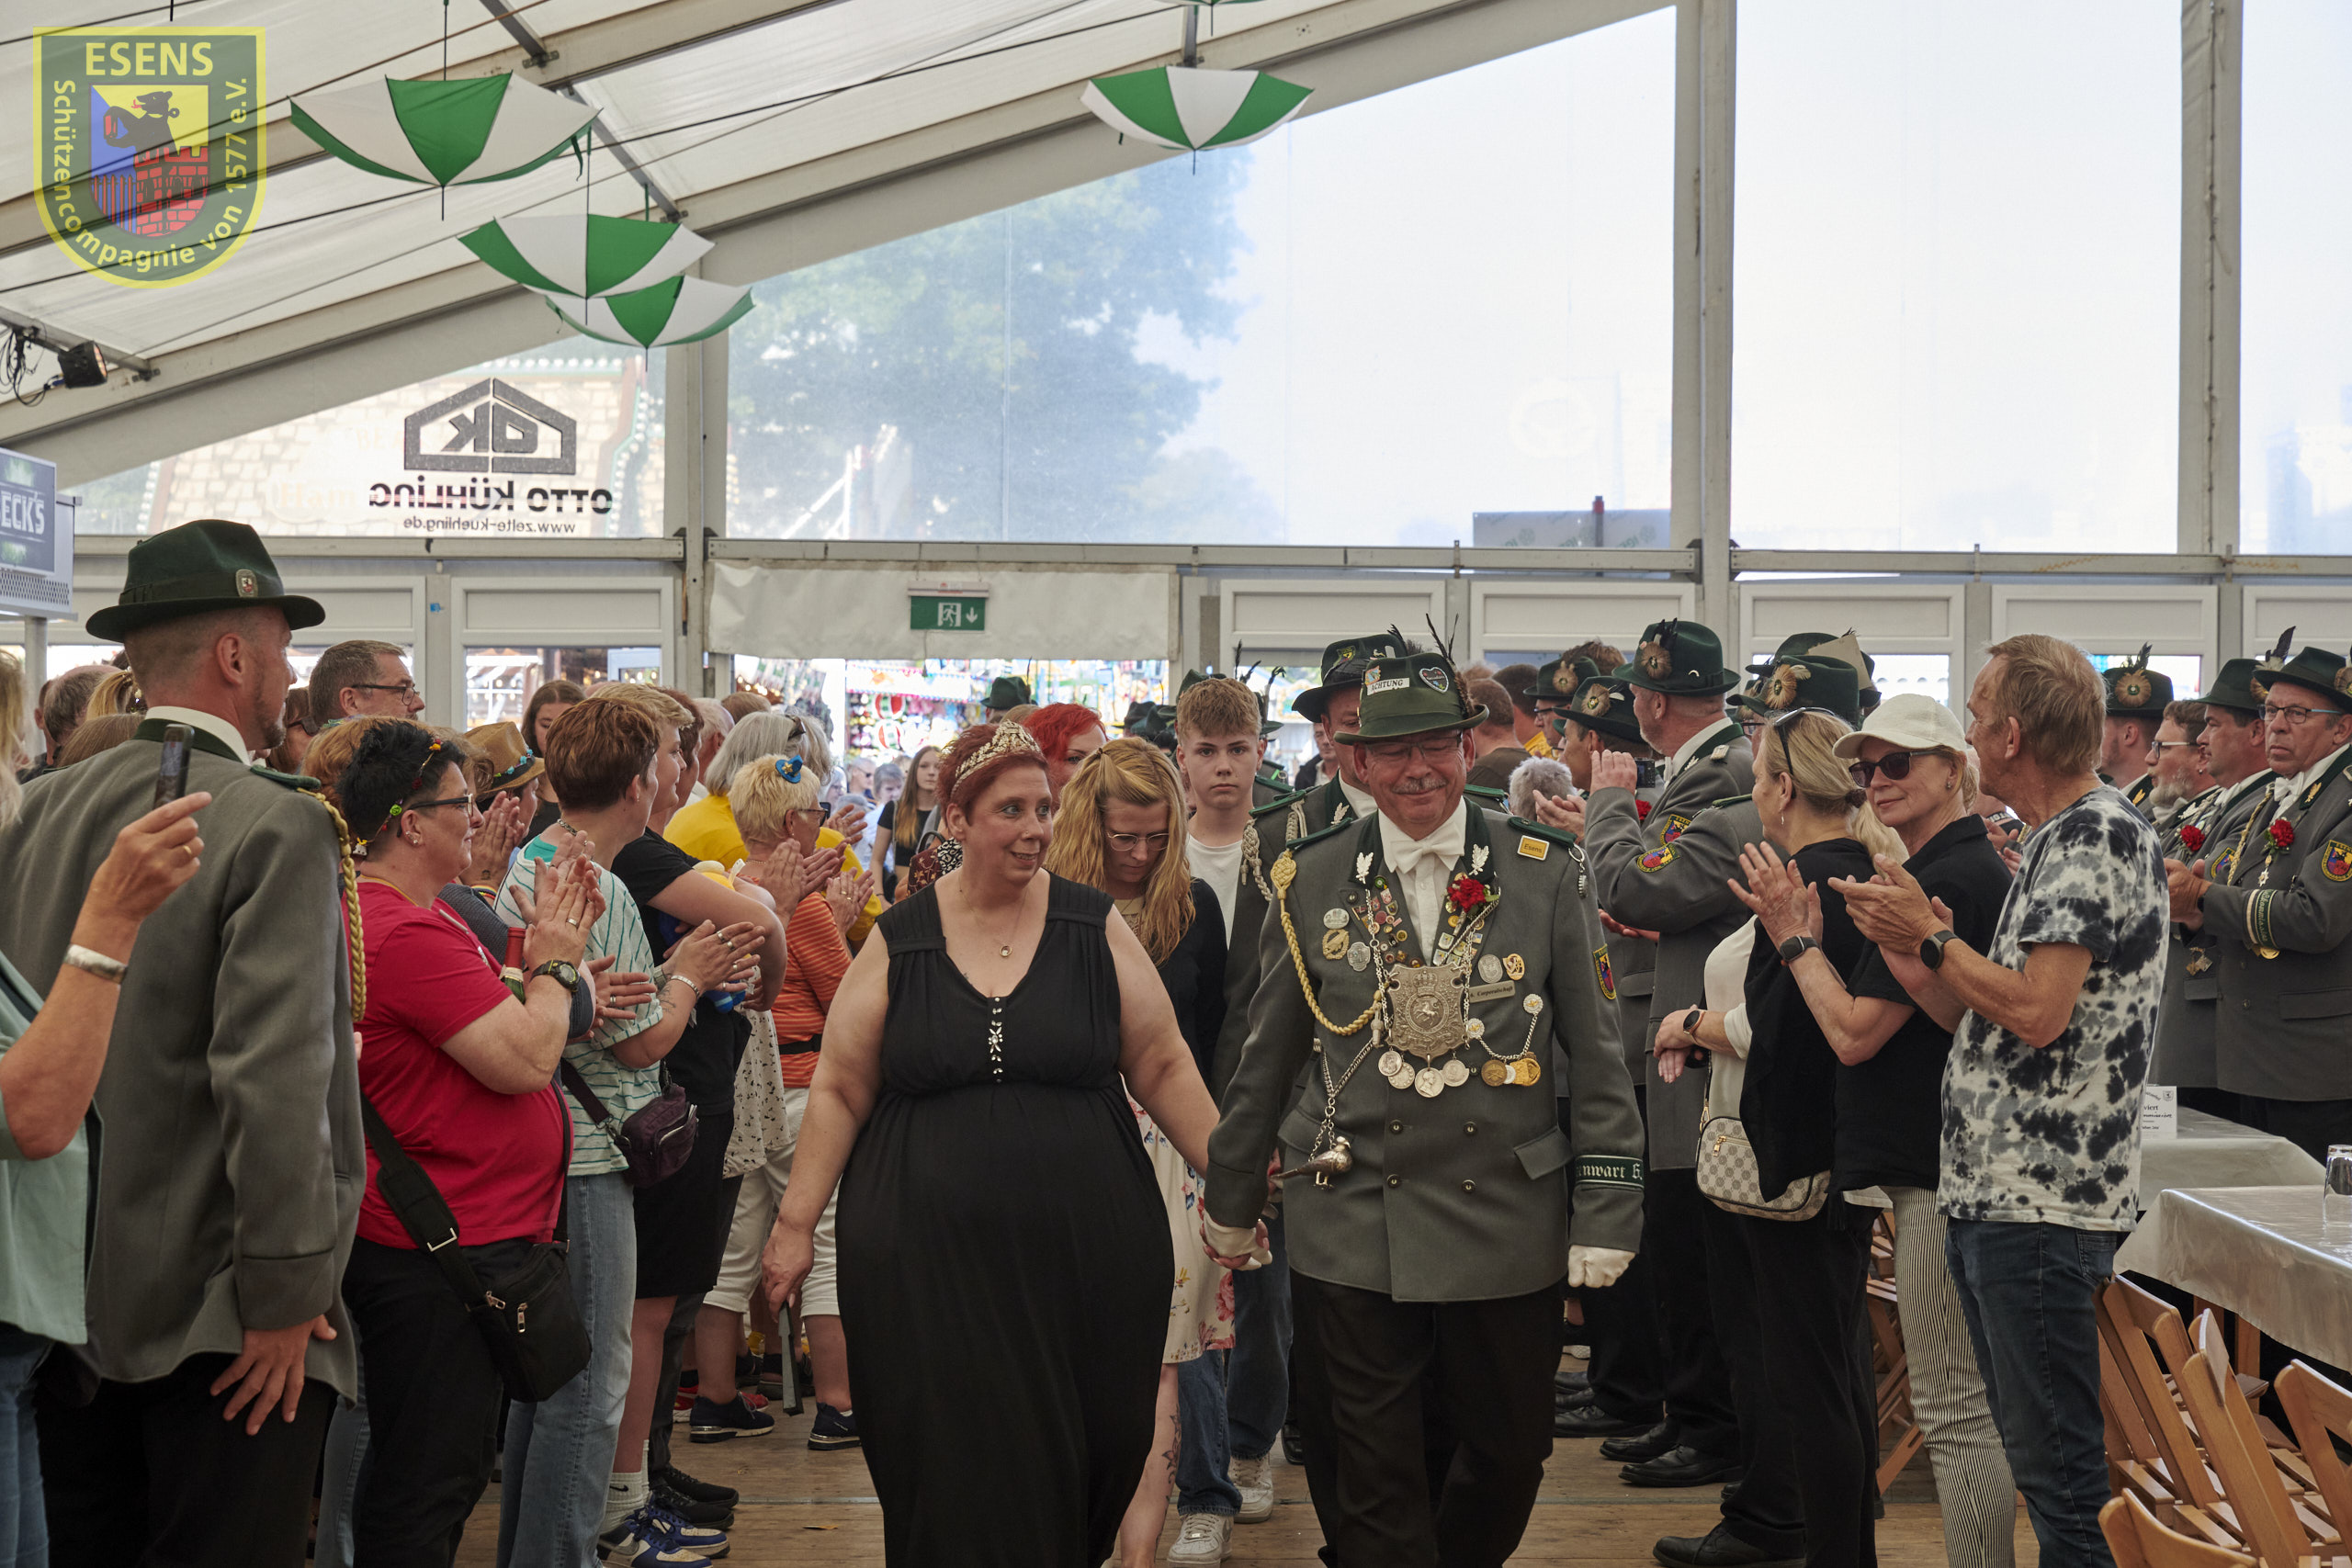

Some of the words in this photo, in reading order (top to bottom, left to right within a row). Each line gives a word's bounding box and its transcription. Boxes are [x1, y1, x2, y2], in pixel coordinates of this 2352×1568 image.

[0, 491, 45, 535] ECK'S
[1372, 680, 1404, 691] ACHTUNG
[1523, 844, 1543, 853] Esens
[1577, 1165, 1626, 1179] nwart
